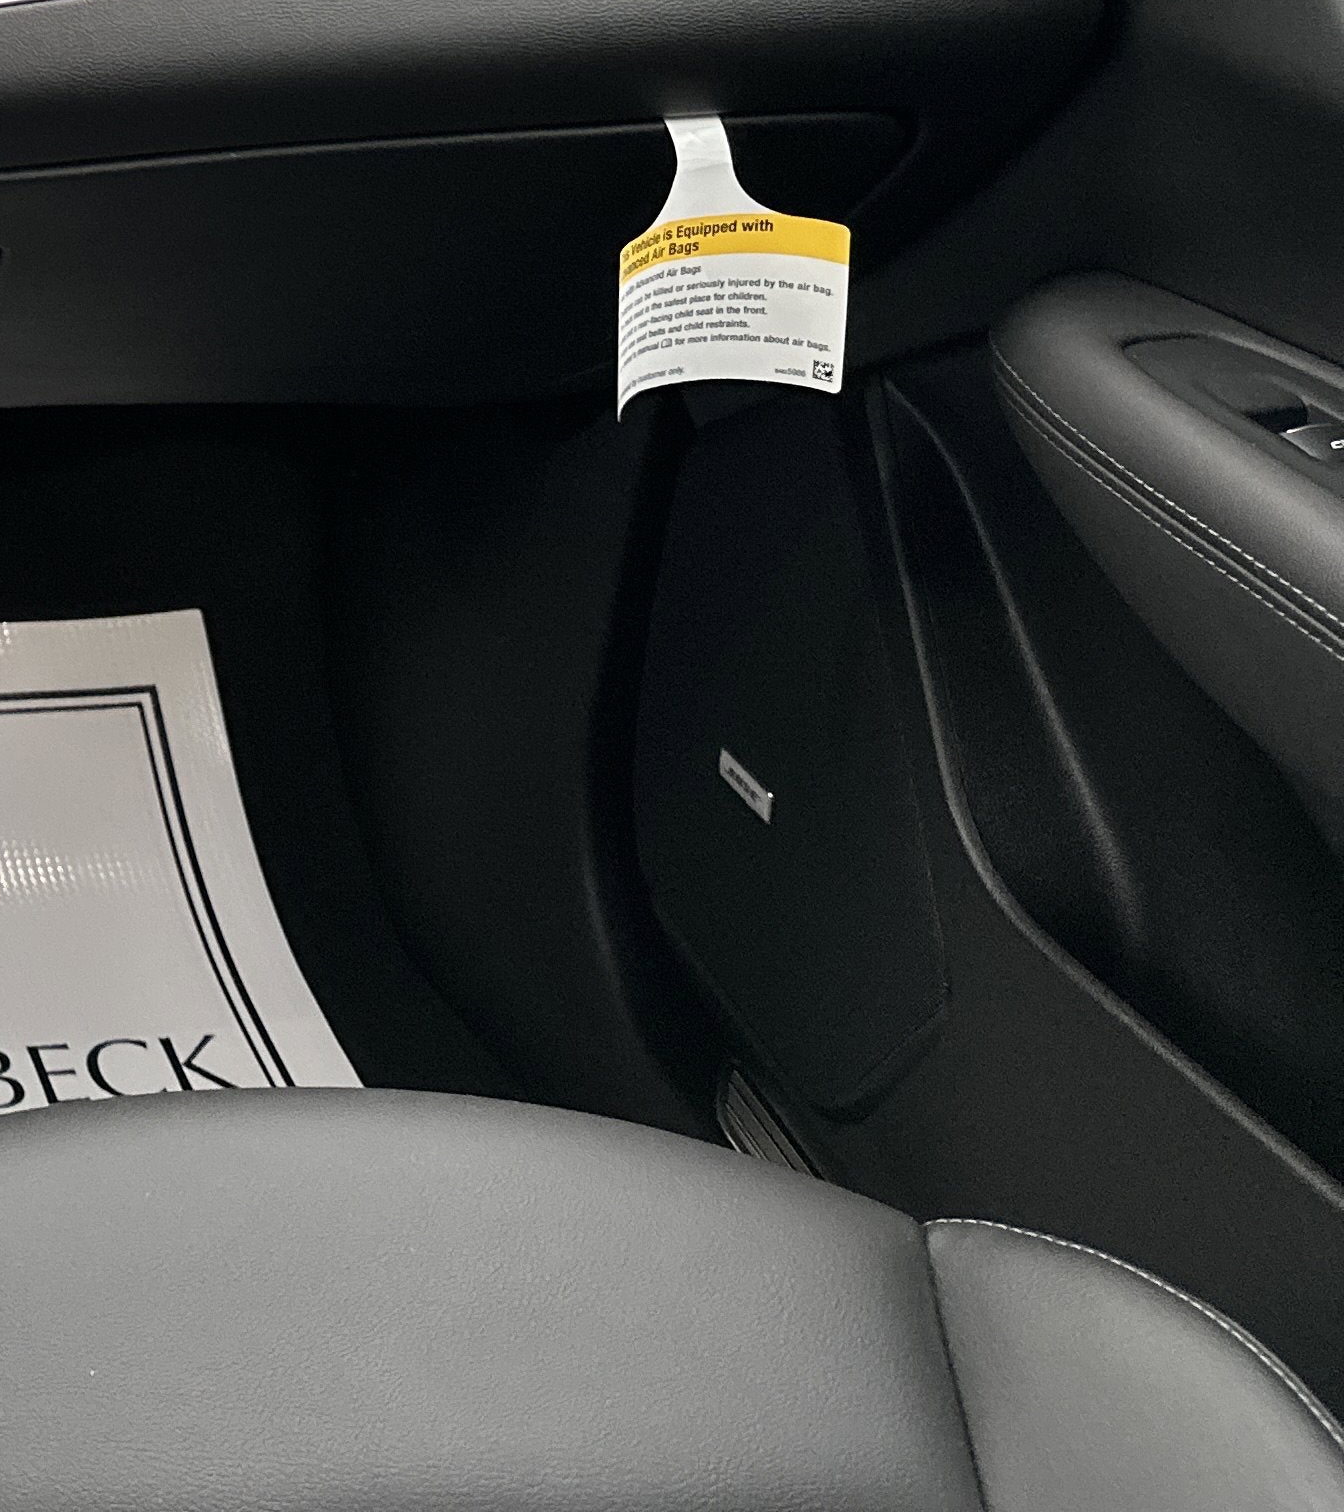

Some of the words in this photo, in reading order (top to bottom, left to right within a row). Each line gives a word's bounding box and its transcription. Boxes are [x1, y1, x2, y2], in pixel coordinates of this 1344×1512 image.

[662, 228, 673, 241] is
[676, 220, 737, 239] Equipped
[742, 219, 774, 232] with
[651, 246, 666, 261] Air
[668, 241, 700, 256] Bags
[680, 265, 702, 276] Bags
[675, 284, 685, 292] or
[686, 279, 725, 290] seriously
[728, 278, 761, 288] injured
[763, 277, 776, 289] by
[778, 279, 794, 289] the
[797, 283, 811, 291] air
[813, 284, 834, 297] bag.
[688, 294, 711, 305] place
[713, 292, 726, 301] for
[728, 292, 767, 301] children.
[674, 309, 694, 319] child
[695, 308, 713, 316] seat
[715, 306, 724, 314] in
[726, 306, 741, 314] the
[743, 306, 768, 315] front.
[667, 324, 682, 334] and
[683, 321, 704, 331] child
[706, 320, 750, 329] restraints.
[687, 336, 708, 344] more
[710, 333, 761, 342] information
[763, 334, 790, 345] about
[792, 338, 805, 346] air
[806, 340, 831, 352] bags.
